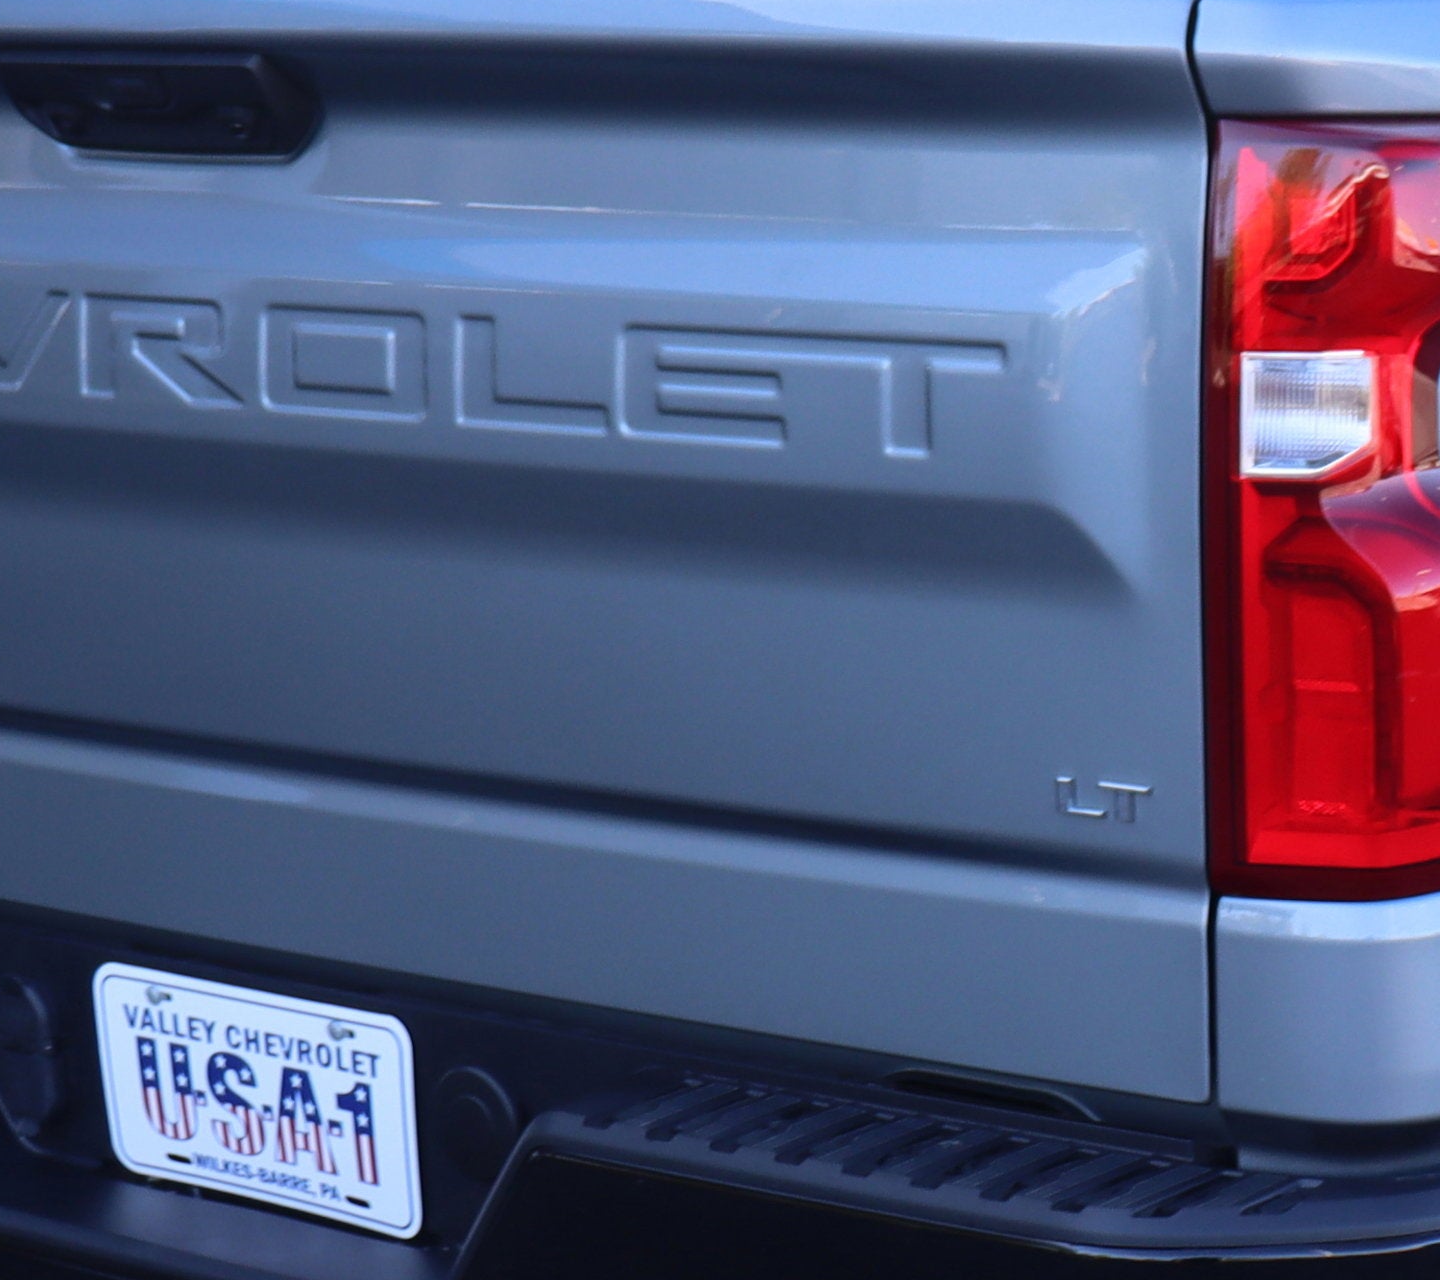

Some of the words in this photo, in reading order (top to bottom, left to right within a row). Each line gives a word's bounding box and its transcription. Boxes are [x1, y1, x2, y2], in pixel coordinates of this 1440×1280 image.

[1054, 775, 1154, 824] LT
[122, 1002, 215, 1044] VALLEY
[225, 1023, 381, 1079] CHEVROLET
[319, 1180, 342, 1202] PA
